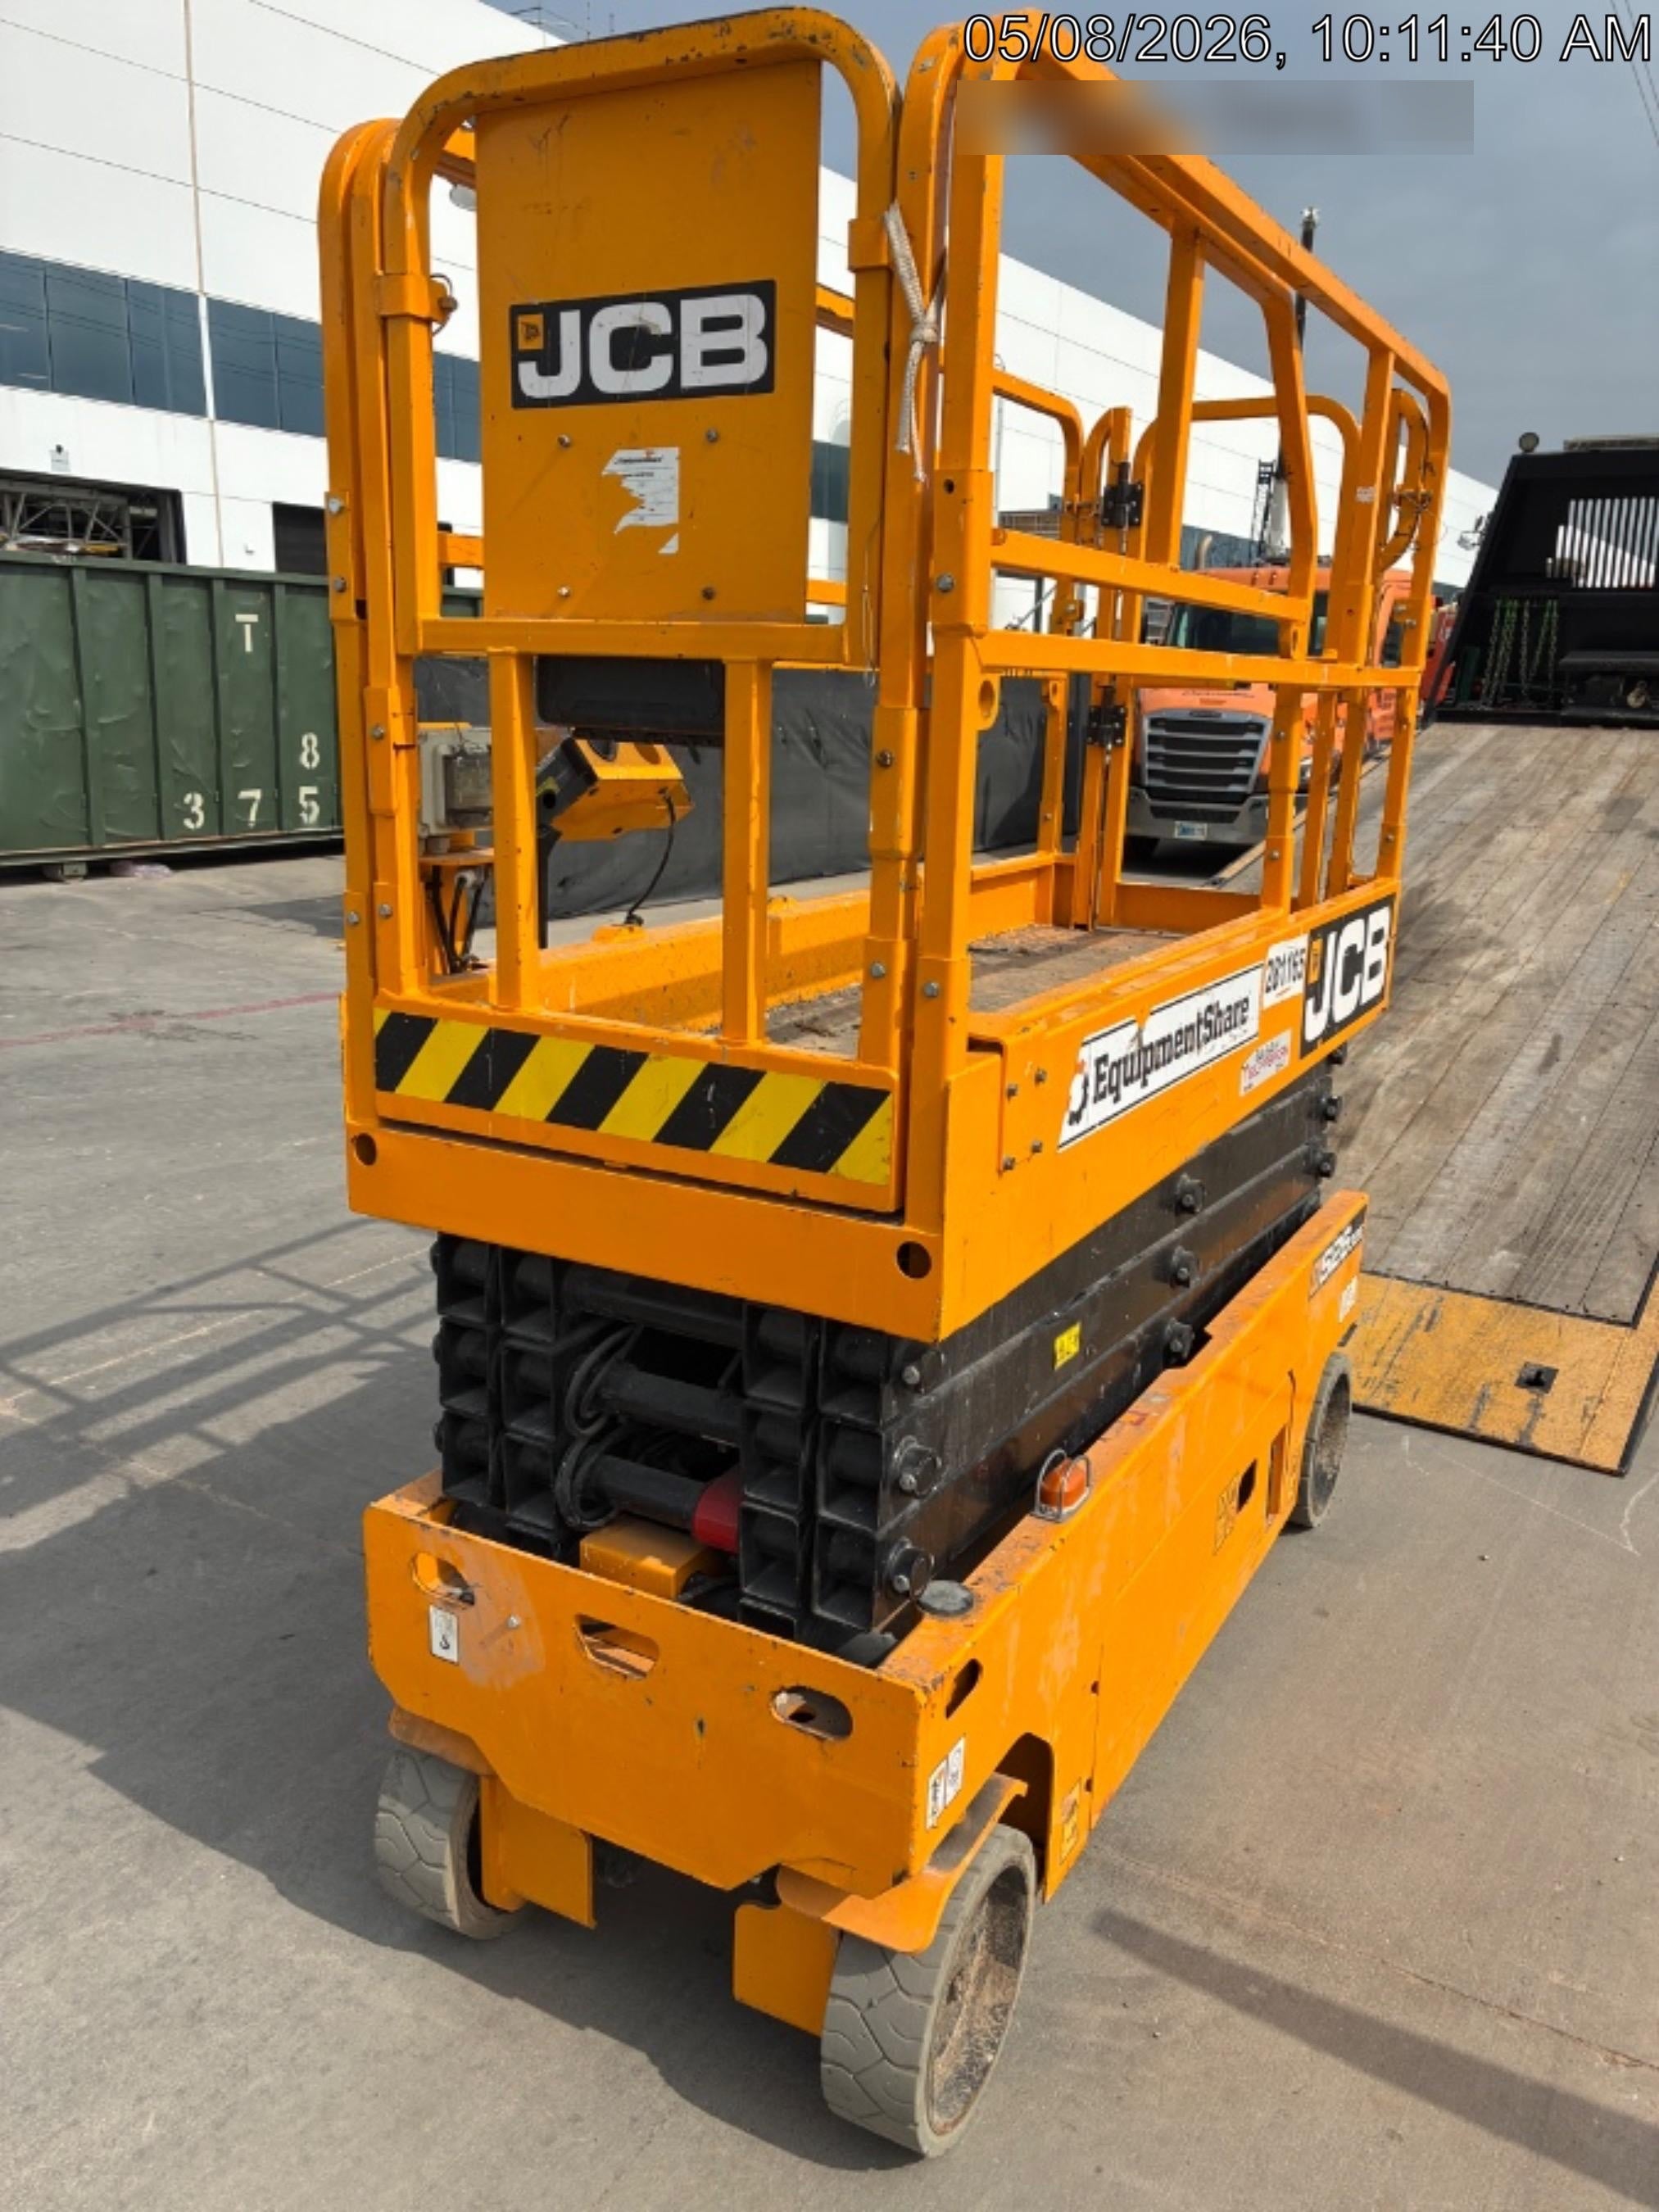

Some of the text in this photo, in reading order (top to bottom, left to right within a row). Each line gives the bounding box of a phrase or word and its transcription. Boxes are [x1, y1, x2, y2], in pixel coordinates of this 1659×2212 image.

[517, 293, 768, 400] JCB
[235, 614, 258, 652] T
[300, 732, 320, 768] 8
[183, 786, 320, 829] 3 7 5
[1304, 906, 1391, 1043] JCB
[1093, 996, 1250, 1104] EquipmentShare
